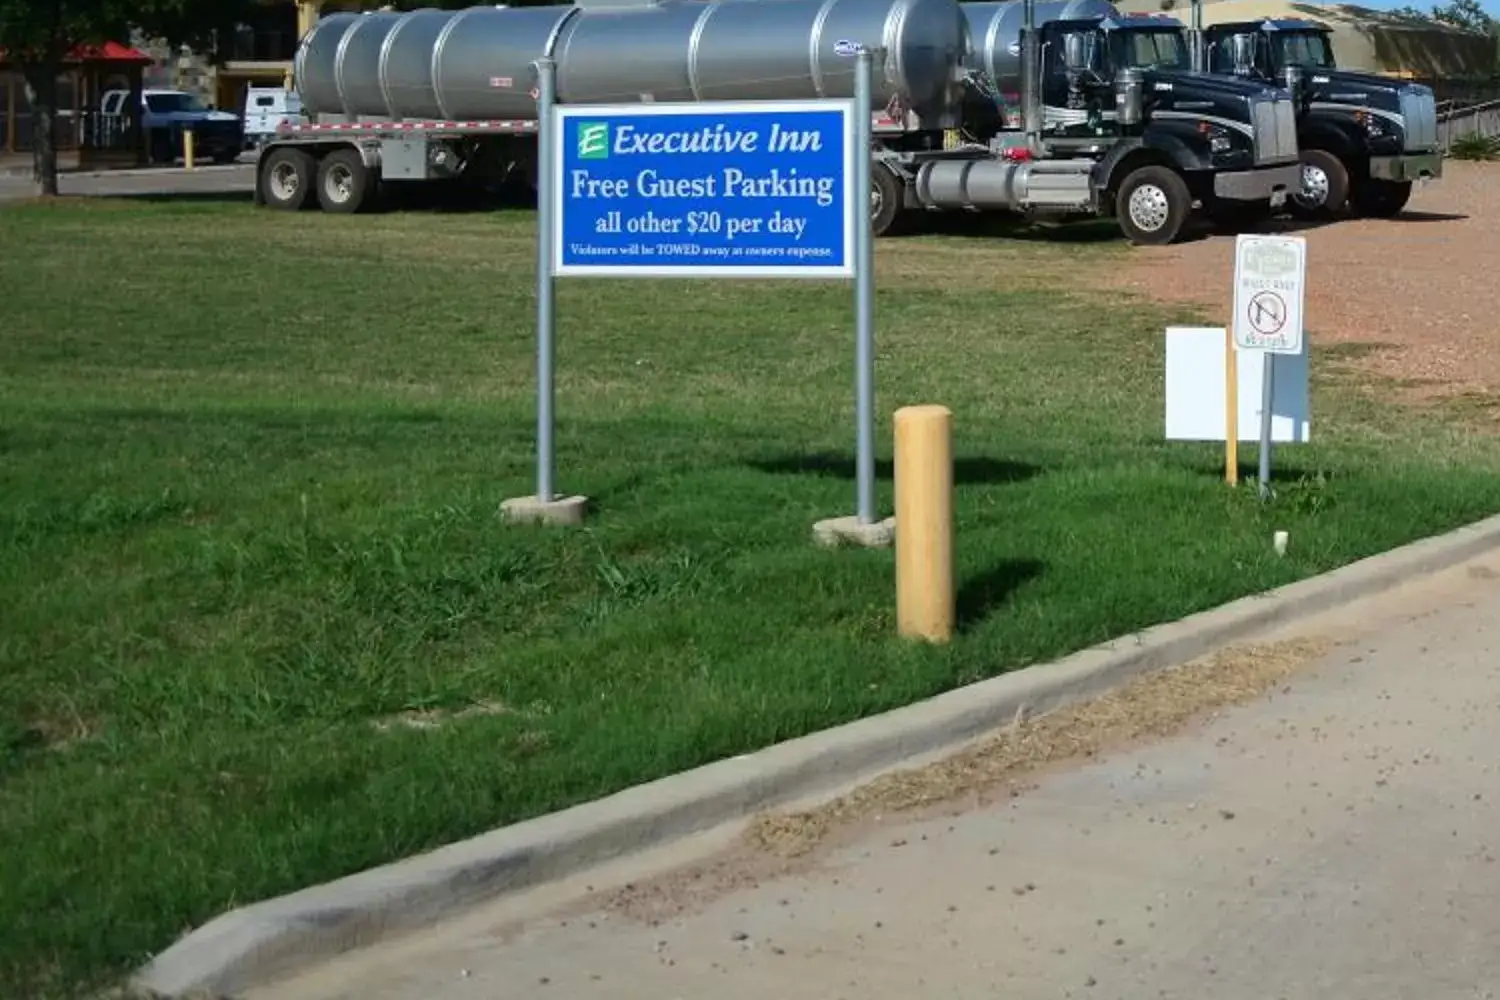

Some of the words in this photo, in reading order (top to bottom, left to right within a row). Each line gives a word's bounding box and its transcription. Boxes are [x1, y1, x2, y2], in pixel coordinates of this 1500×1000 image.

[614, 124, 757, 155] Executive
[767, 123, 823, 153] Inn
[571, 169, 629, 198] Free
[637, 168, 716, 198] Guest
[723, 168, 835, 206] Parking
[595, 211, 621, 233] all
[627, 211, 682, 233] other
[687, 211, 721, 236] $20
[726, 215, 762, 239] per
[768, 211, 807, 240] day
[620, 243, 639, 255] will
[641, 243, 655, 255] be
[656, 243, 701, 256] TOWED
[703, 247, 731, 259] away
